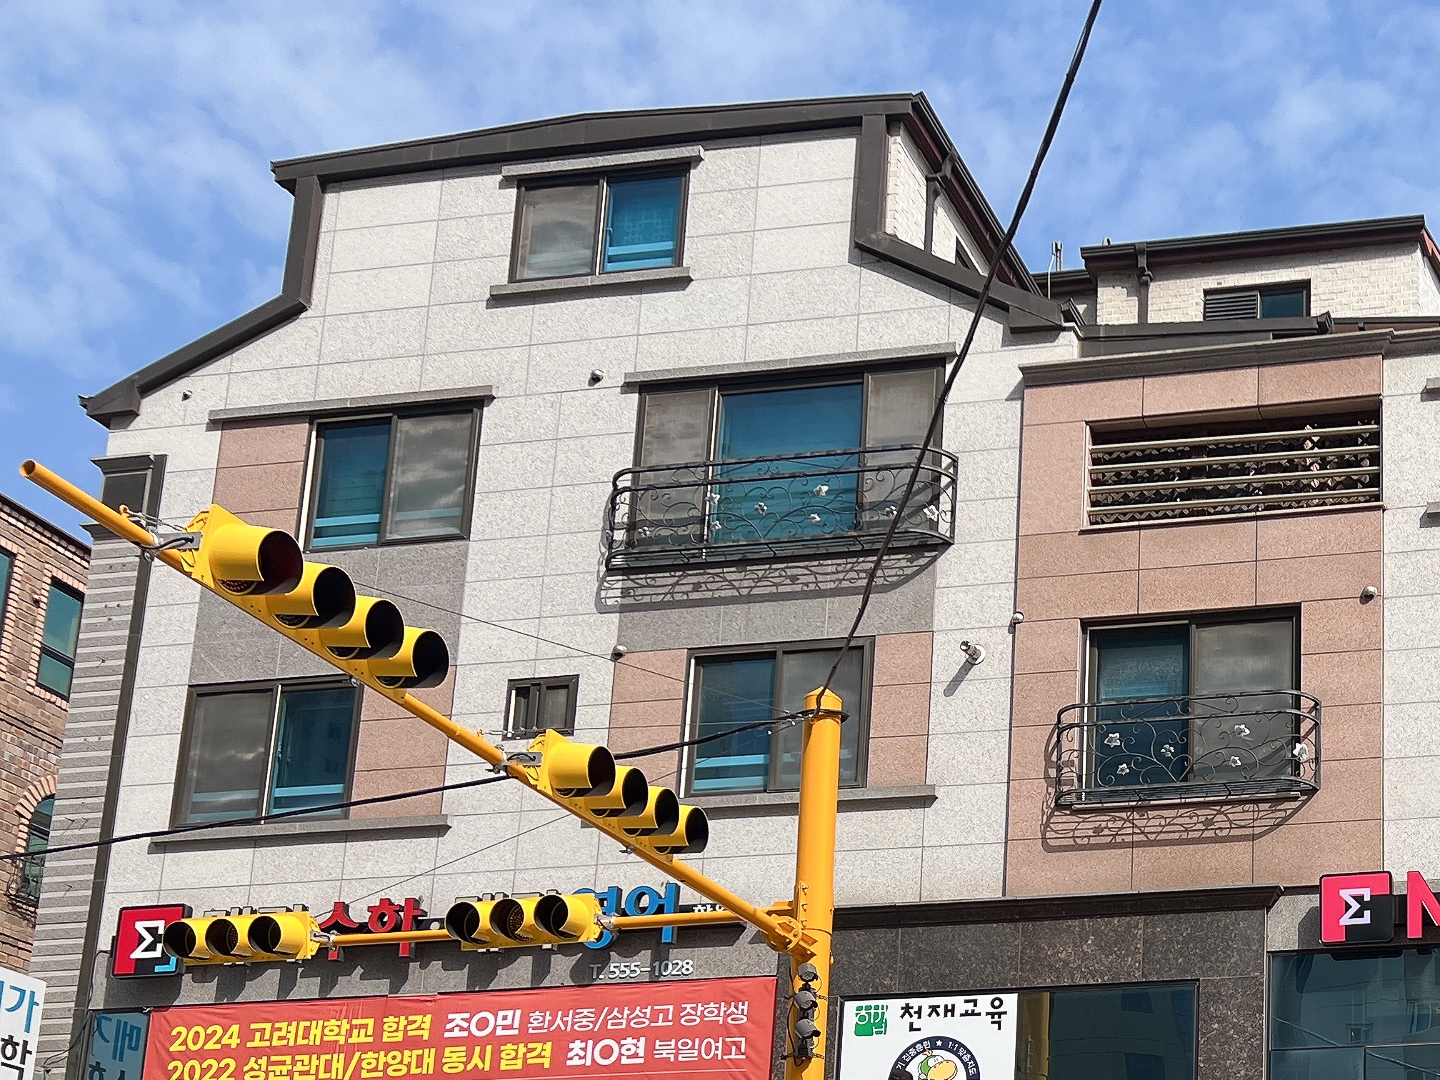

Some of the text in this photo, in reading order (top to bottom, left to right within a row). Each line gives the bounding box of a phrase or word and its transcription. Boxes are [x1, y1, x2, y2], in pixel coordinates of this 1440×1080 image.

[608, 959, 694, 978] 555-1028
[169, 1024, 241, 1052] 2024
[246, 1016, 375, 1048] 고려대학교
[381, 1013, 432, 1044] 합격
[526, 1004, 674, 1034] 환서중/삼성고
[678, 1000, 749, 1026] 장학생
[900, 996, 1008, 1032] 천재교육
[441, 1044, 492, 1074] 동시
[499, 1041, 552, 1071] 합격
[652, 1036, 747, 1063] 북일여고
